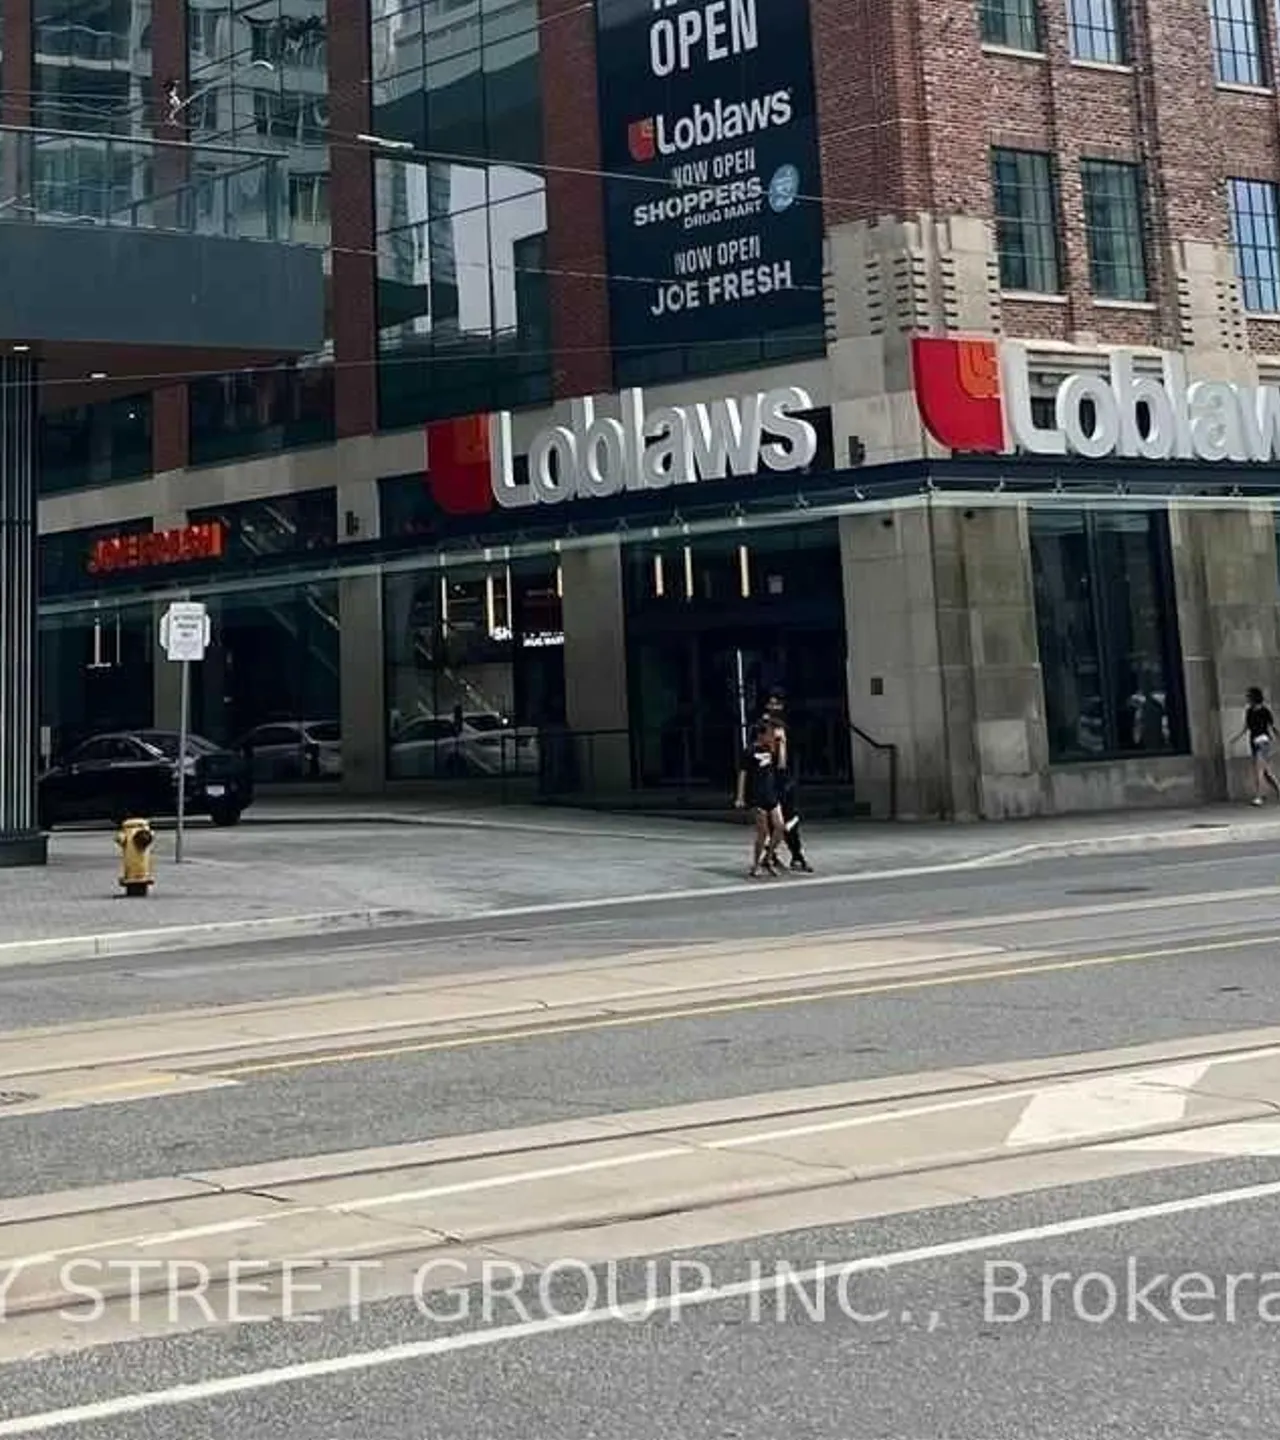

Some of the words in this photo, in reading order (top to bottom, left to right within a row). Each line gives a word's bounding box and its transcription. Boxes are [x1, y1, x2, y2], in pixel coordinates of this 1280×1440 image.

[656, 89, 792, 155] Loblaws
[673, 160, 709, 188] NOW
[712, 147, 756, 179] OPEN
[633, 176, 763, 227] SHOPPERS
[684, 211, 721, 229] DRUG
[723, 200, 762, 220] MART
[674, 245, 712, 275] NOW
[717, 235, 761, 265] OPEN
[651, 280, 701, 316] JOE
[707, 260, 793, 306] FRESH
[489, 385, 818, 508] Loblaws
